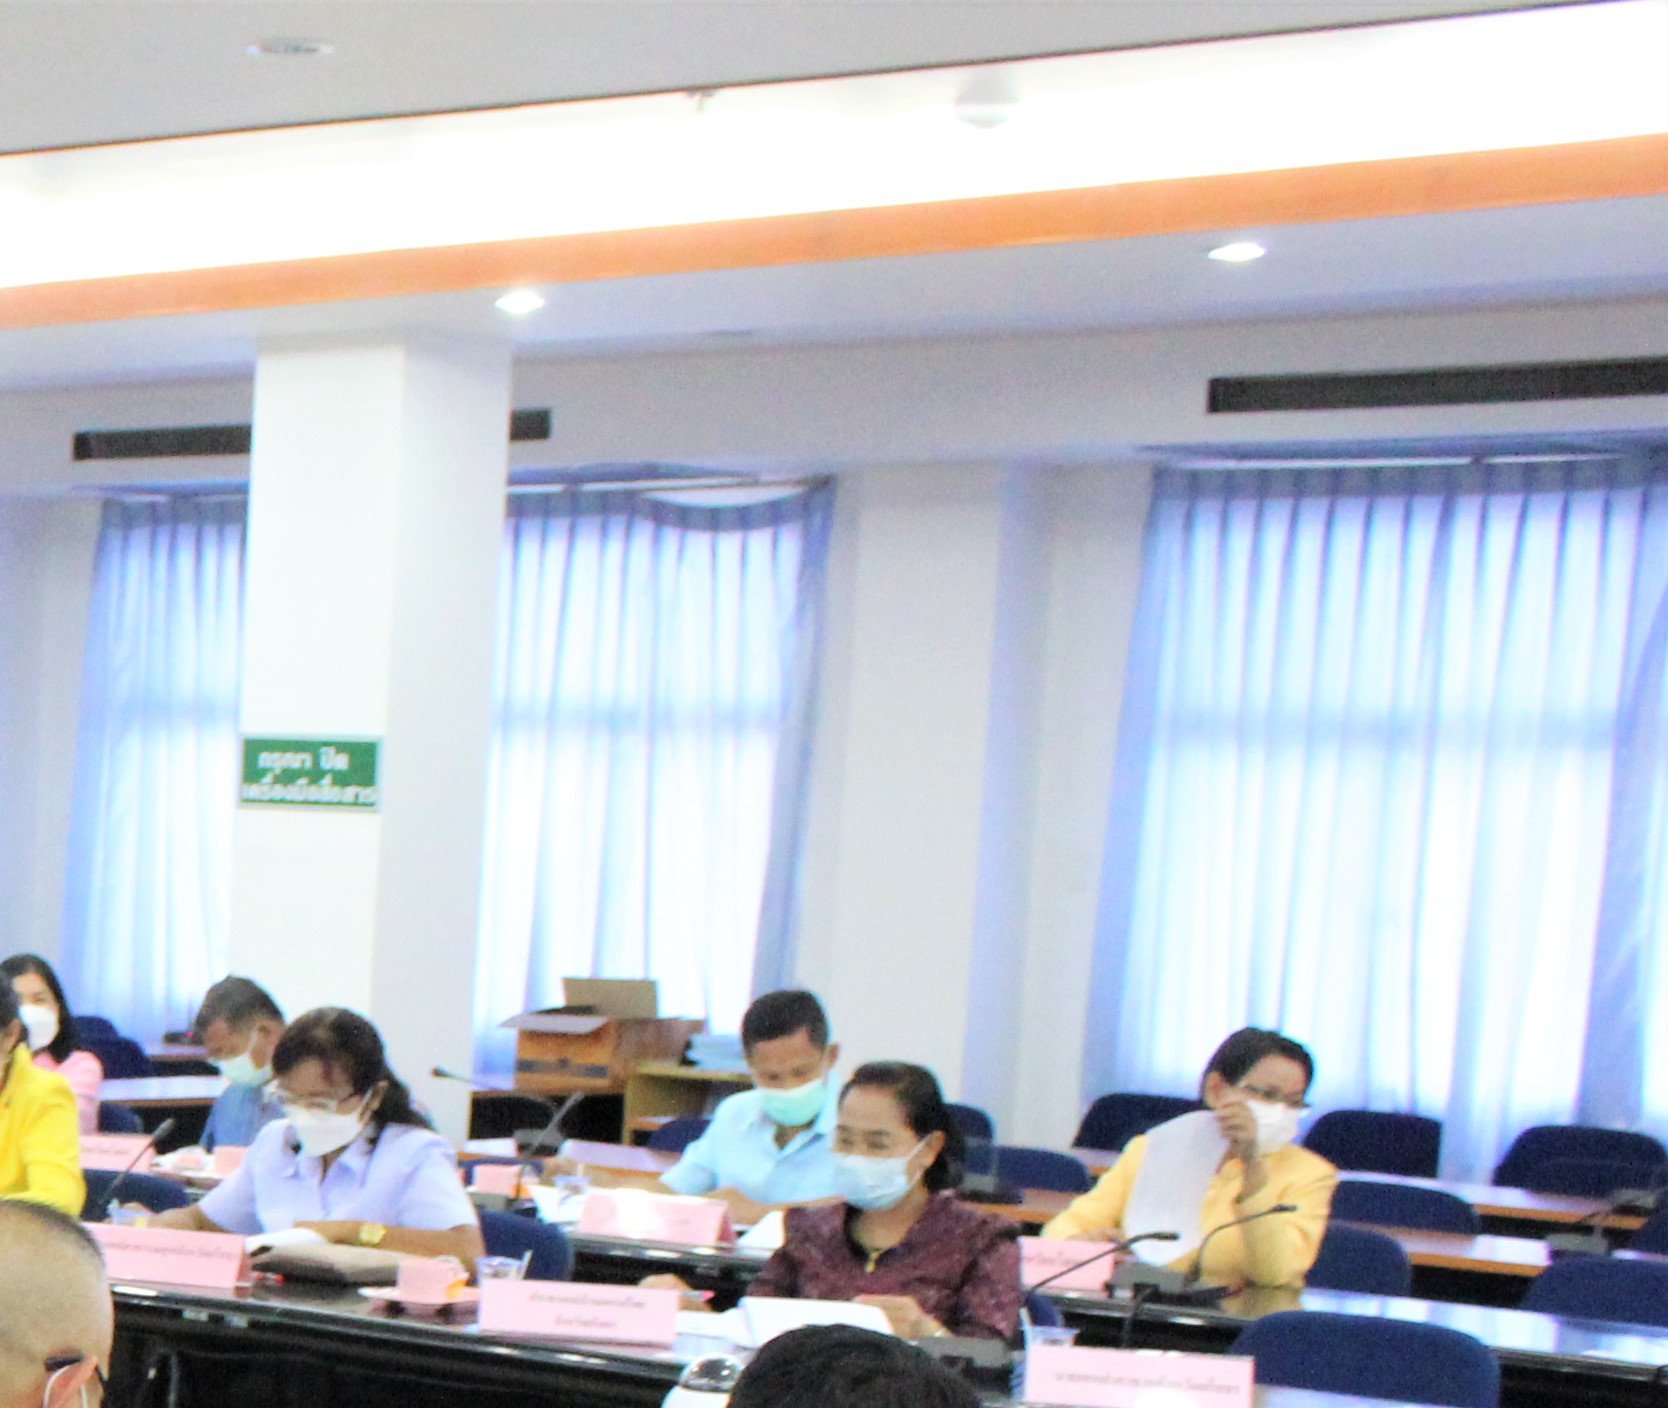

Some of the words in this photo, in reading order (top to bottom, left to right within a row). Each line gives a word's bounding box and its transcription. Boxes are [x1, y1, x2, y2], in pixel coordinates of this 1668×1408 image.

[257, 750, 314, 776] กรุณา
[319, 745, 350, 770] ปิด
[241, 772, 377, 805] เครื่องมือสื่อสาร
